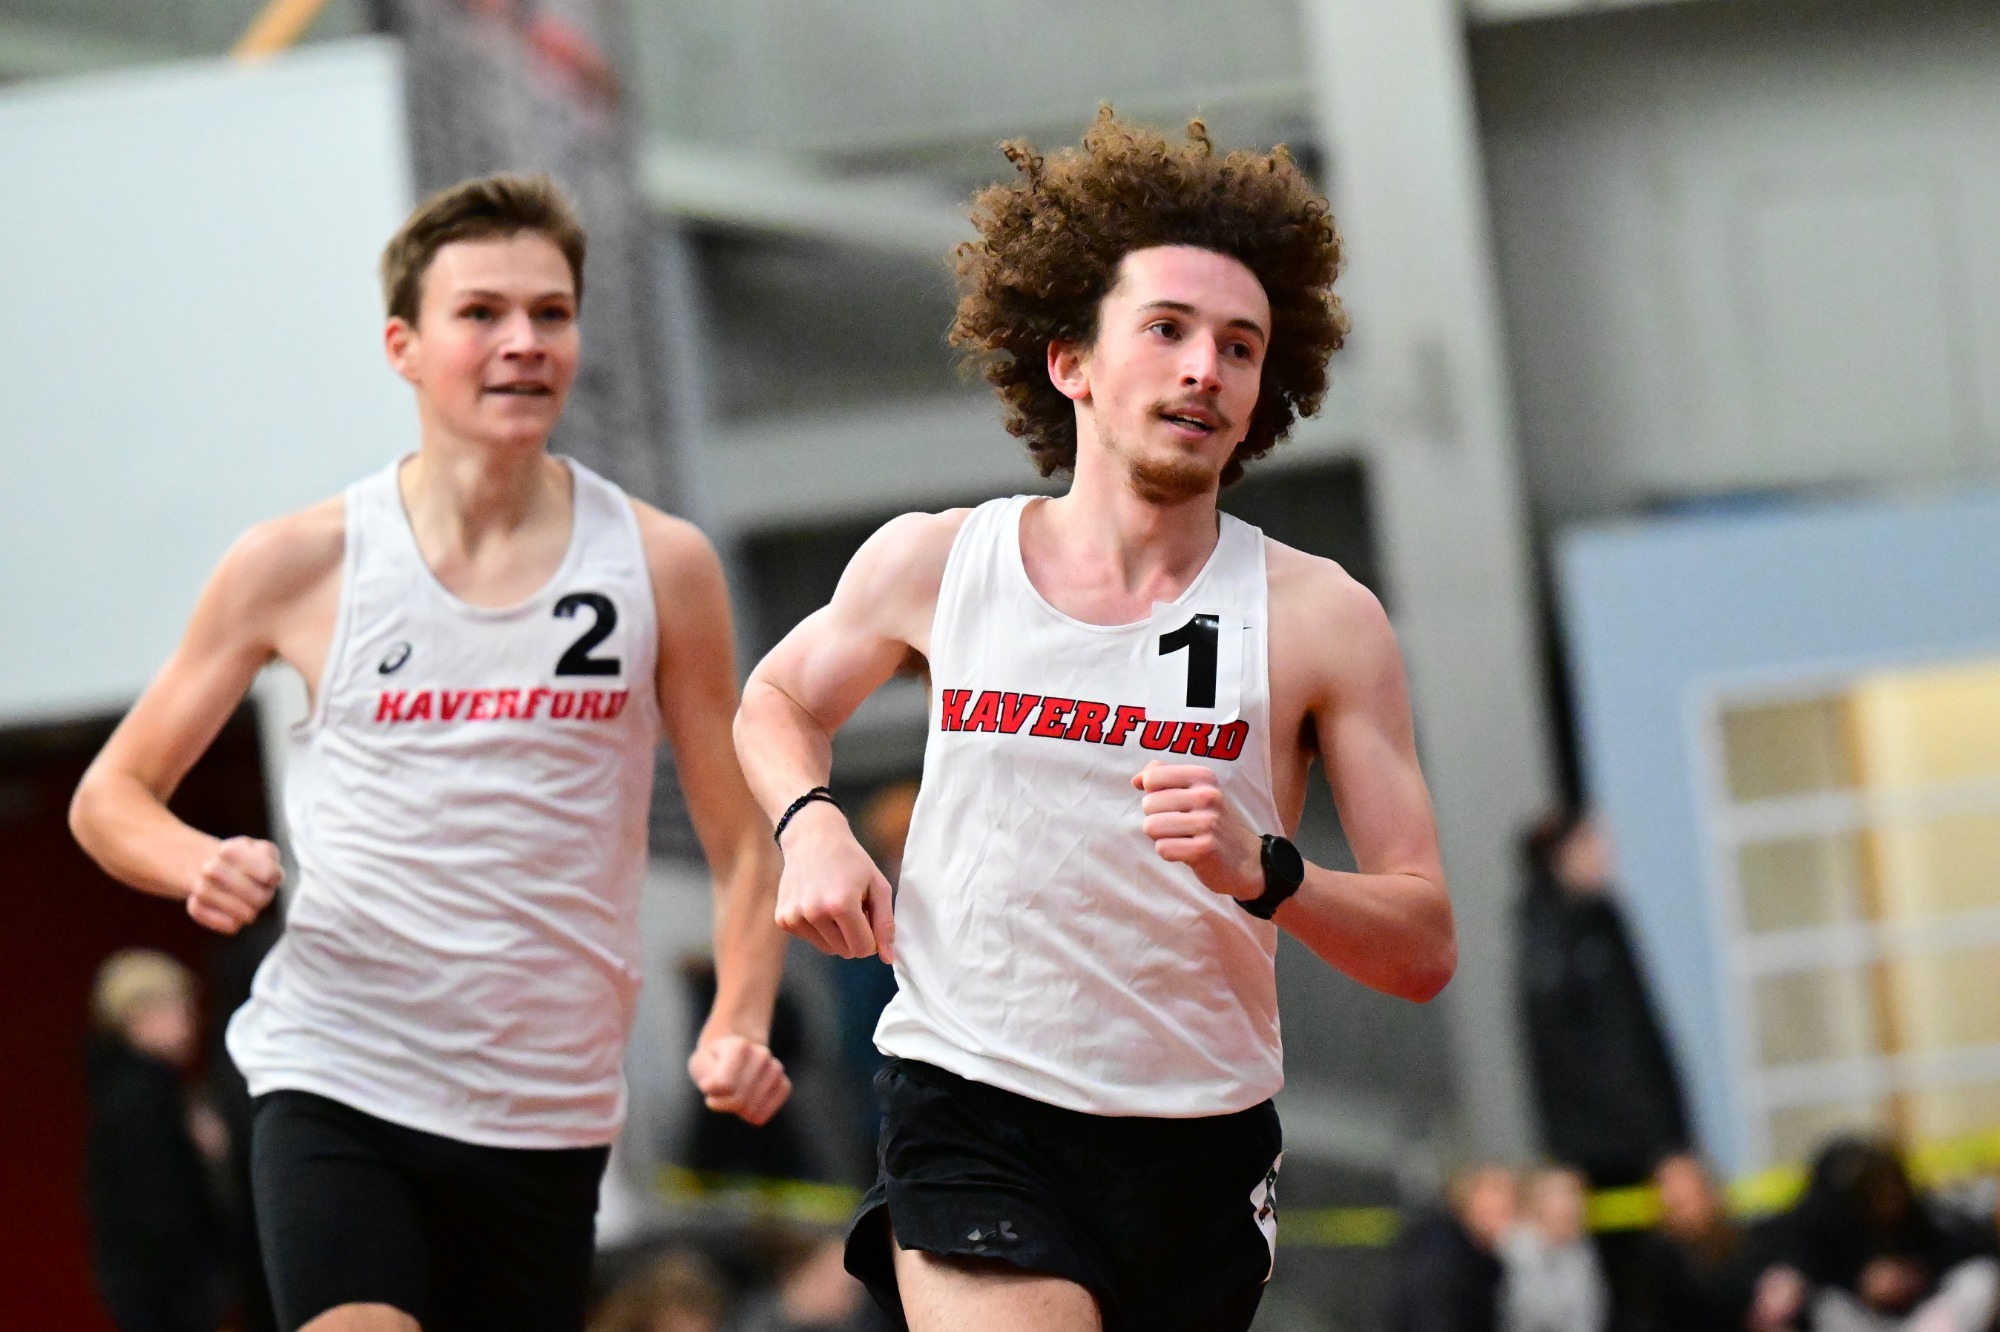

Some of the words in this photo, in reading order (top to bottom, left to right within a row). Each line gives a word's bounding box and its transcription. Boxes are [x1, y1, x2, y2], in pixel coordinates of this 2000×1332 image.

[553, 591, 621, 676] 2
[1158, 613, 1220, 709] 1
[375, 687, 629, 723] HAVERFORD
[941, 689, 1250, 761] HAVERFORD
